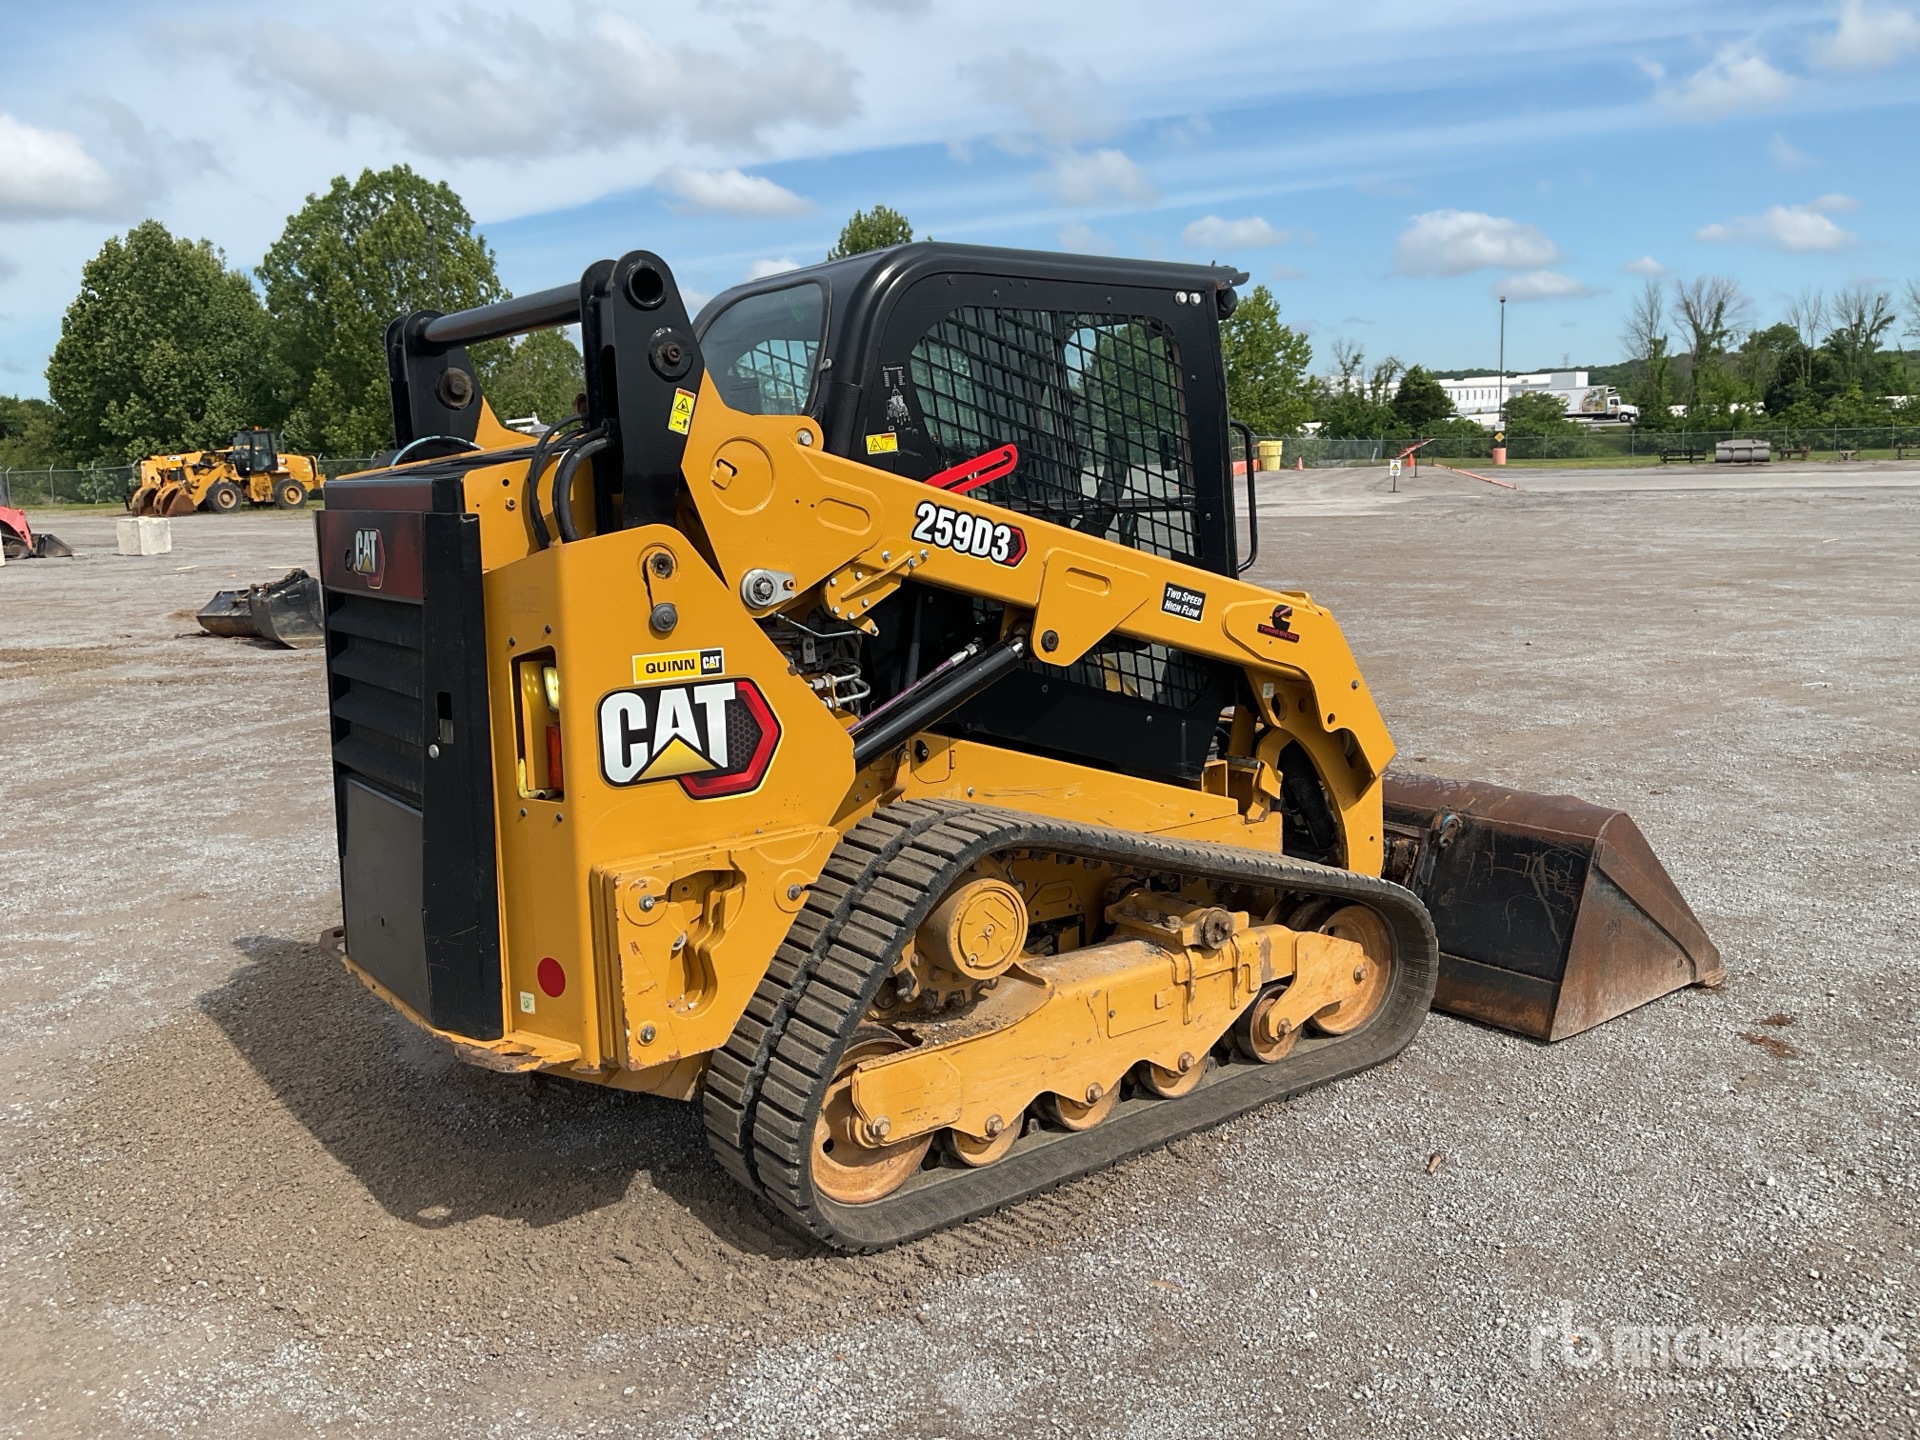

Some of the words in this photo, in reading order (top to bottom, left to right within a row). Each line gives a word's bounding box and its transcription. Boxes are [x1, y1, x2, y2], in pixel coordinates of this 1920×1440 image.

[355, 530, 377, 573] CAT
[912, 502, 1012, 562] 259D3
[645, 658, 696, 674] QUINN
[702, 655, 721, 669] CAT
[600, 681, 736, 784] CAT
